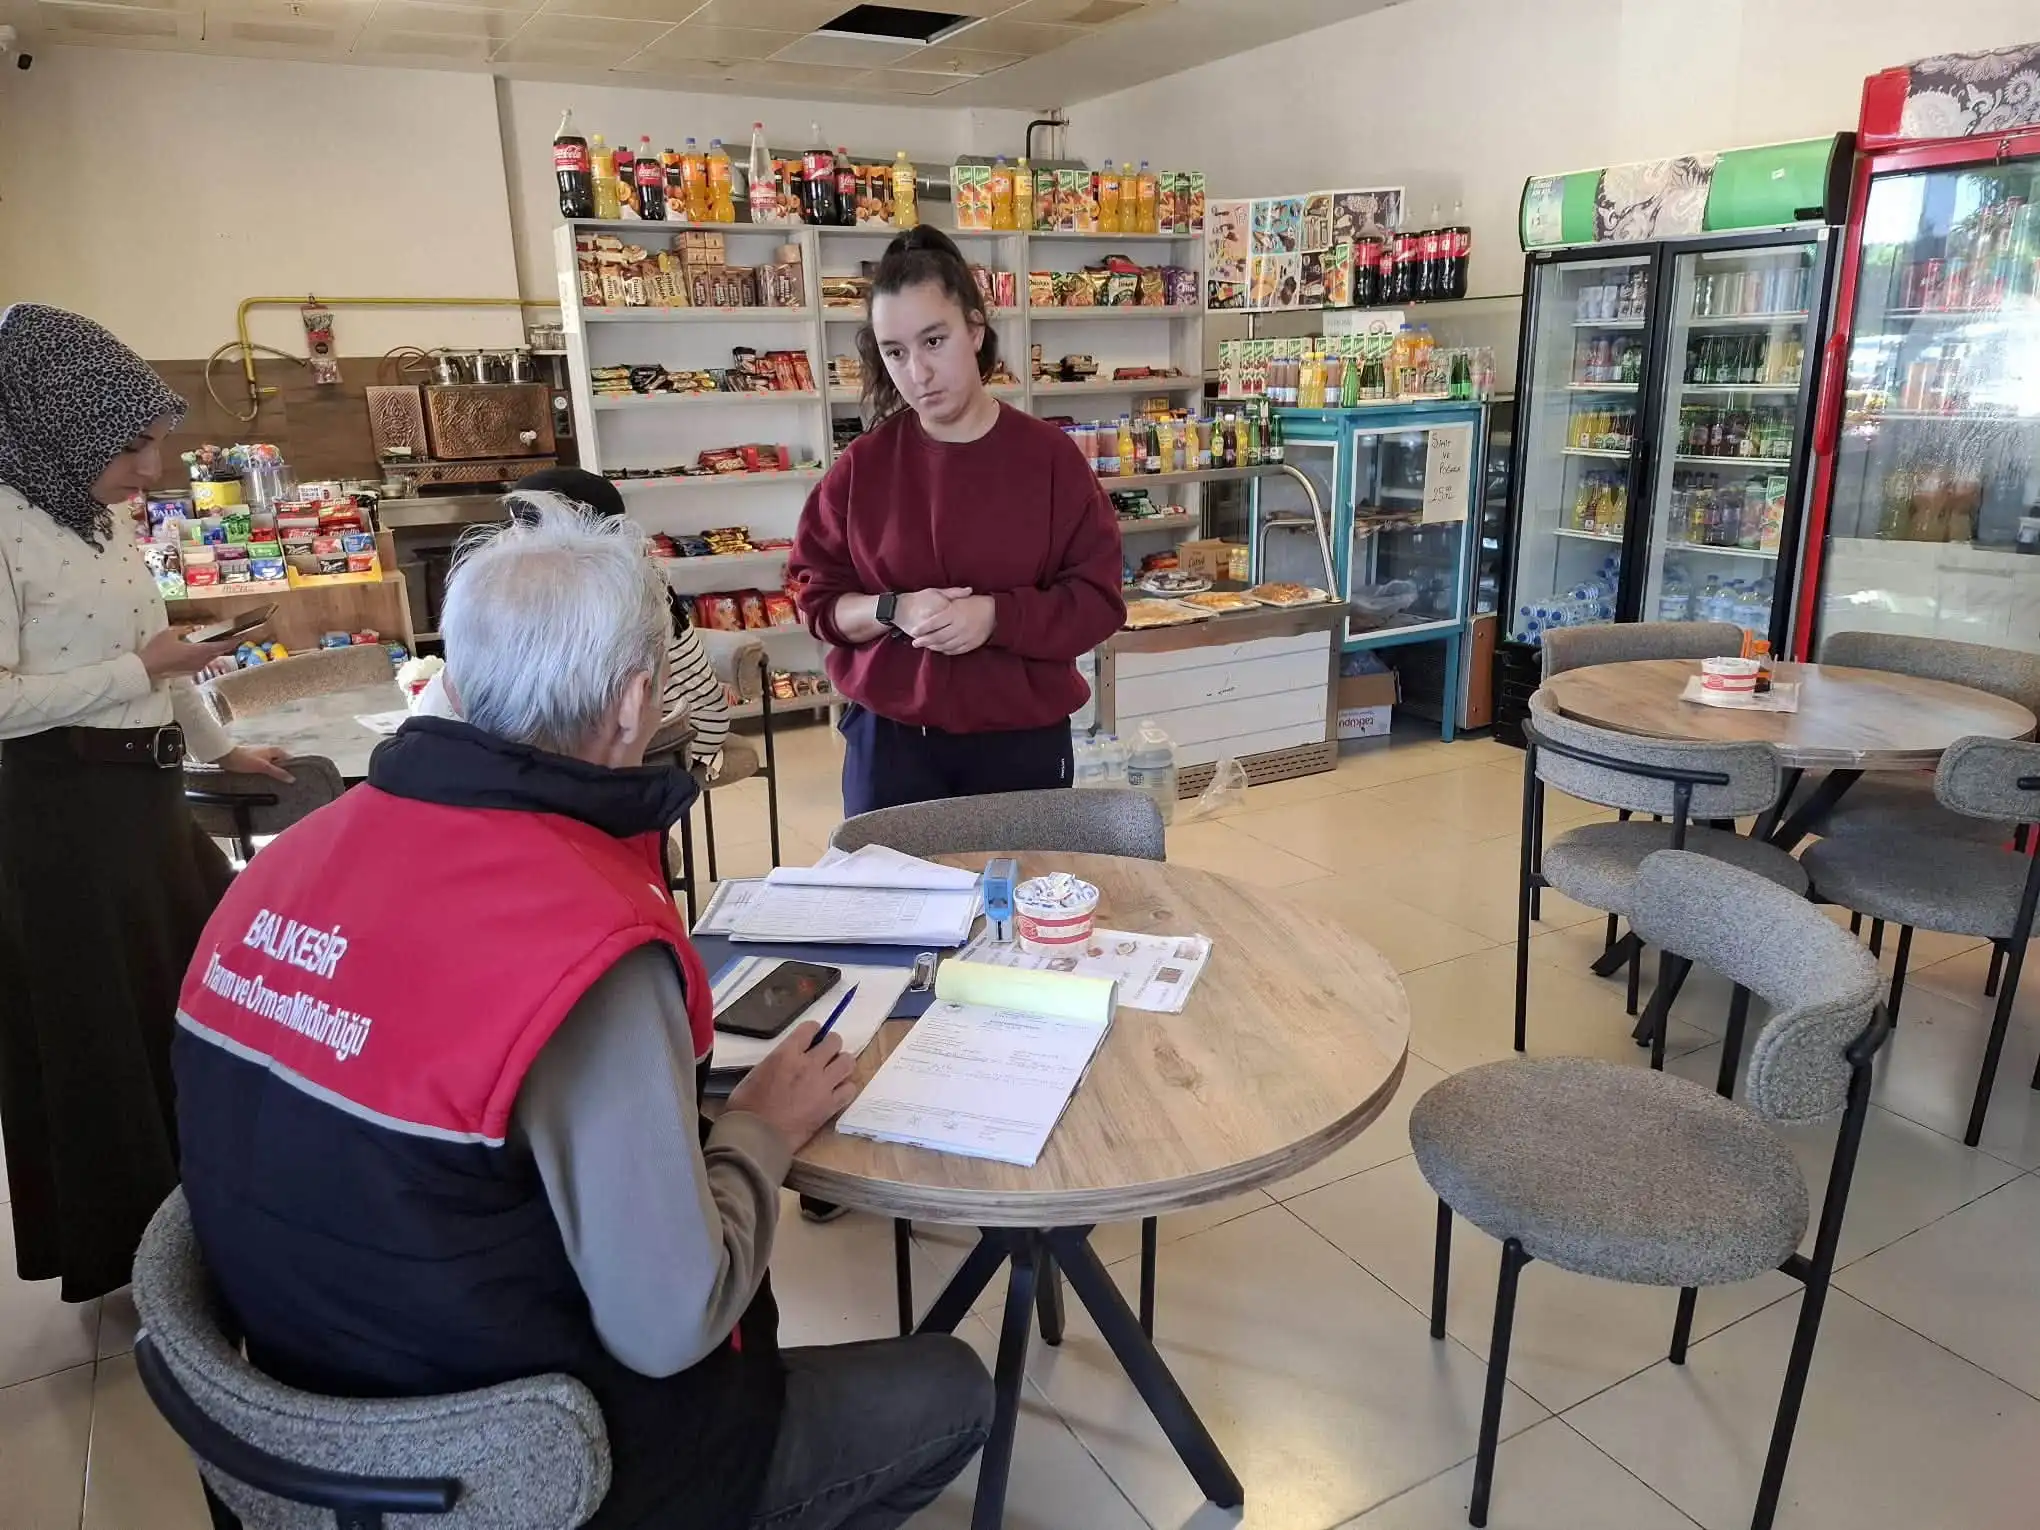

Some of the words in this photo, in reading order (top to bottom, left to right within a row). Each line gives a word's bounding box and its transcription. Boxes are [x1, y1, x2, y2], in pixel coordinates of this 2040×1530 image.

[243, 908, 348, 980] BALIKESİR
[231, 976, 249, 1006] ve
[246, 974, 294, 1027] Orman
[288, 990, 373, 1062] Müdürlüğü
